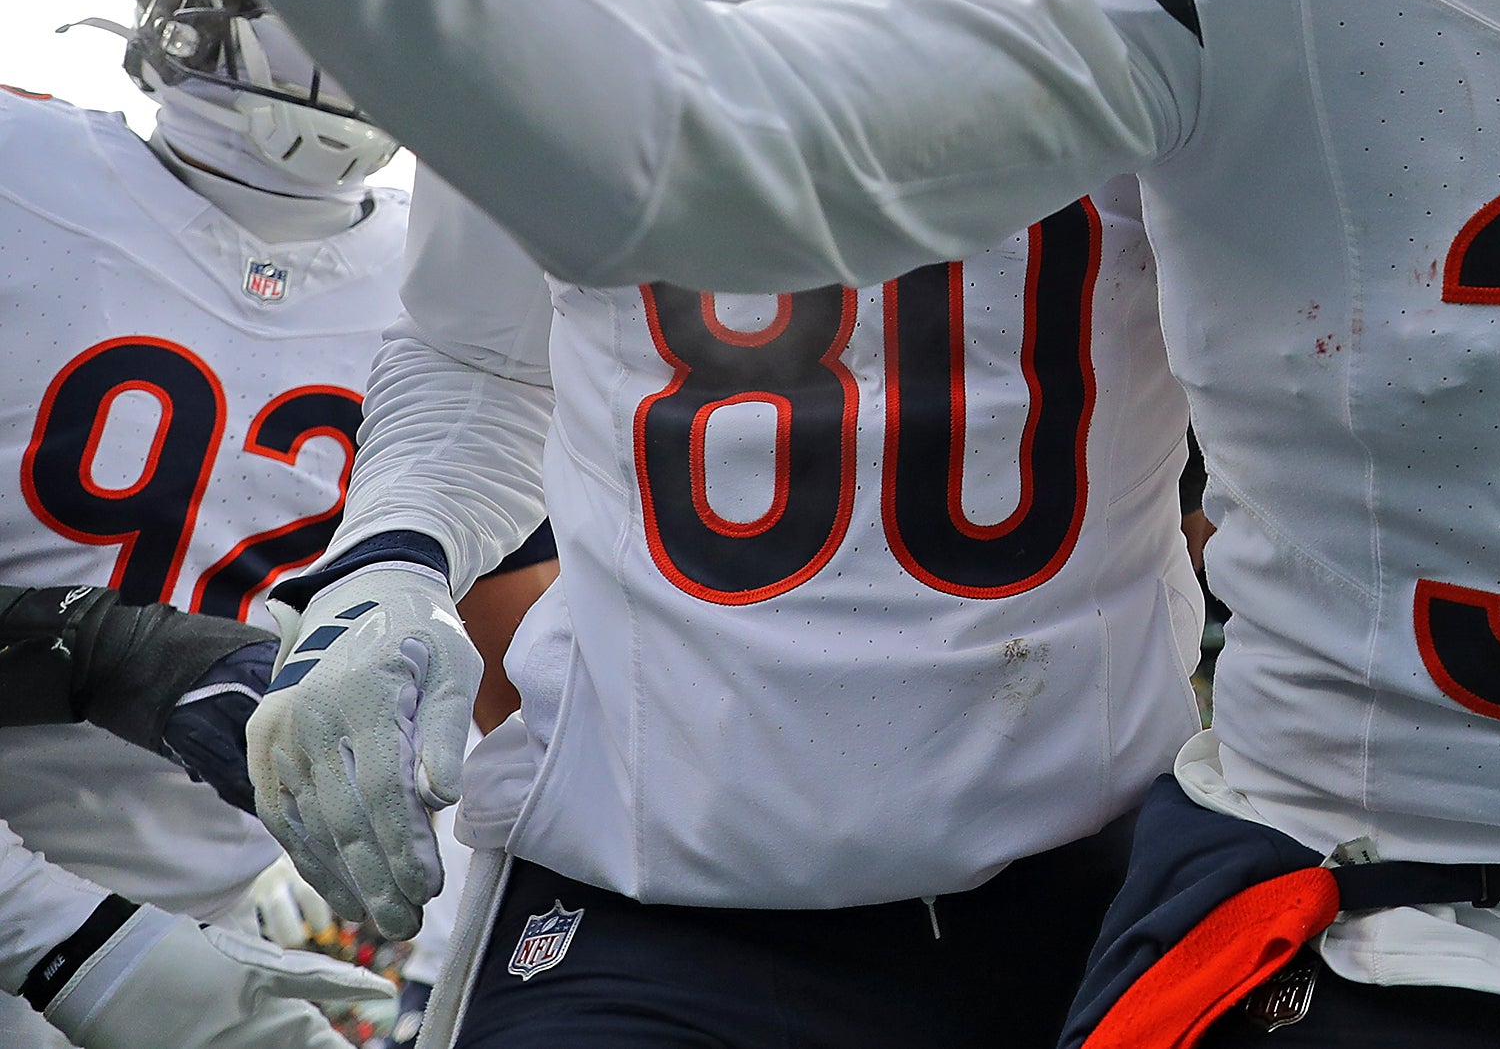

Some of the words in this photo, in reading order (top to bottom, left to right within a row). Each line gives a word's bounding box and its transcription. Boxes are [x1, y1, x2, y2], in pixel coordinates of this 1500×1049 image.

[250, 274, 281, 296] NFL
[20, 335, 366, 622] 92
[633, 194, 1103, 606] 80
[516, 935, 560, 965] NFL
